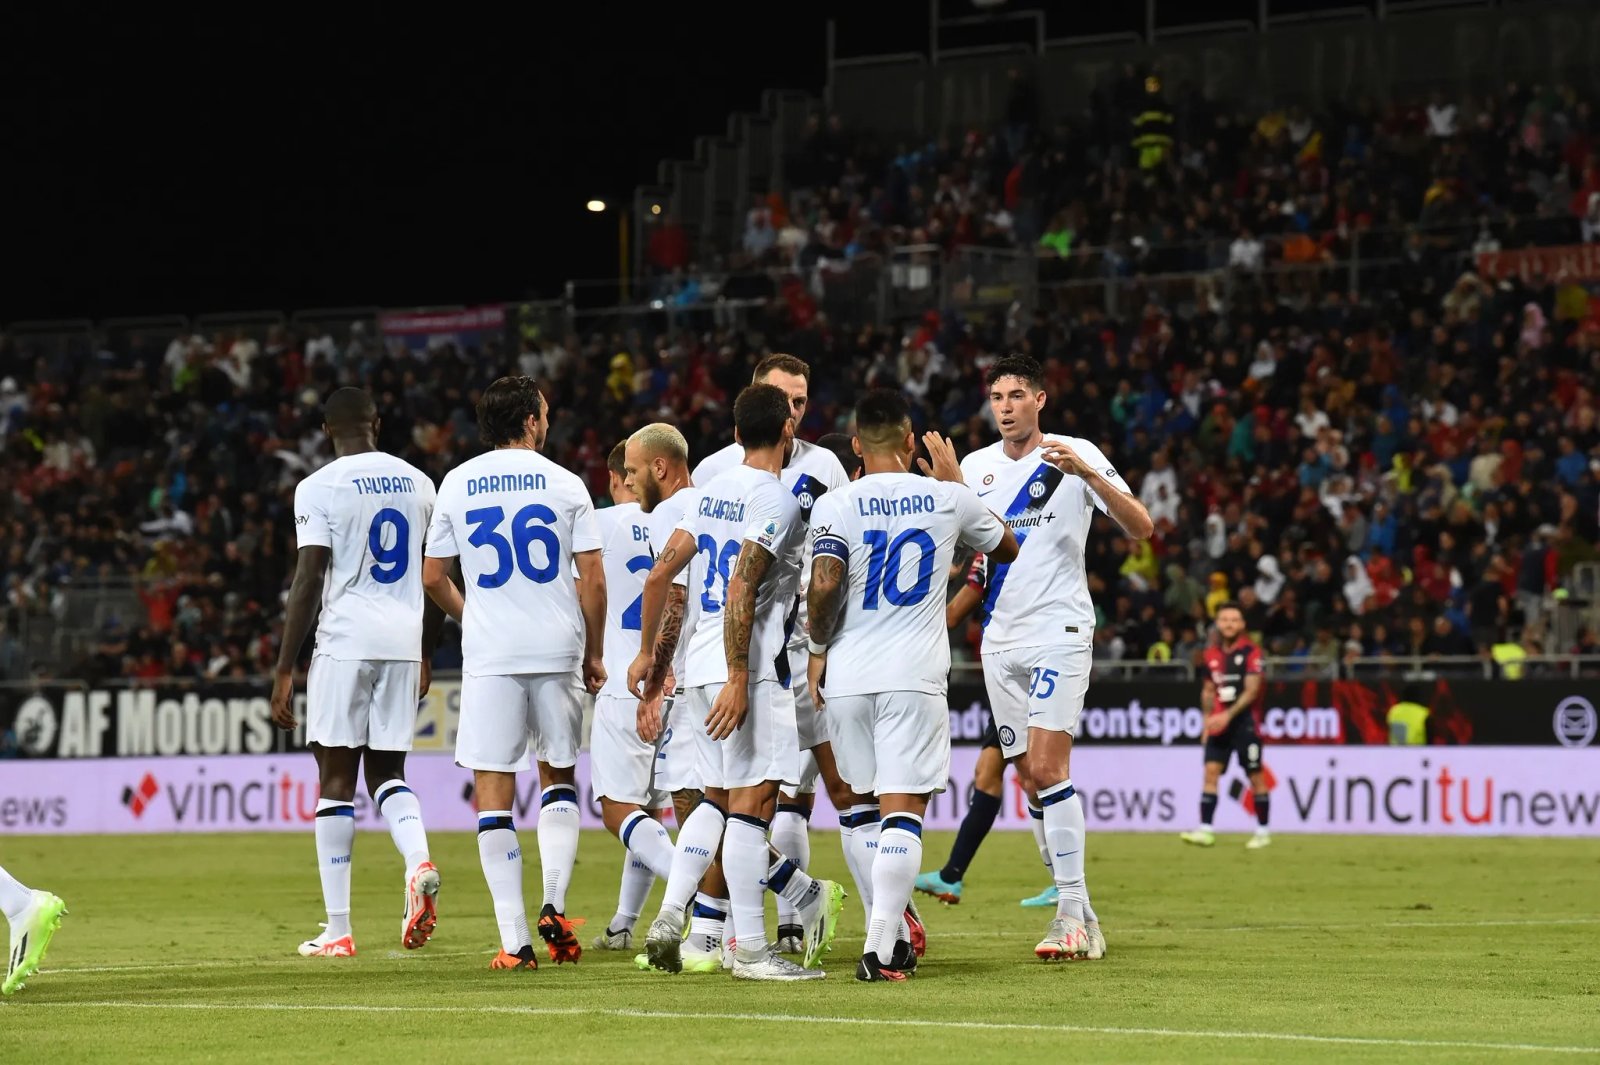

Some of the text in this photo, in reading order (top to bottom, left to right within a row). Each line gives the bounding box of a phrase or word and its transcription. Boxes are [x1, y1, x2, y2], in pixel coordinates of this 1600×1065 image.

[352, 475, 416, 495] THURAM
[467, 473, 546, 496] DARMIAN
[859, 494, 935, 517] LAUTARO
[1004, 512, 1056, 528] mount+
[369, 507, 409, 584] 9
[466, 503, 560, 589] 36
[814, 543, 838, 552] EACE
[862, 527, 936, 611] 10
[621, 555, 655, 630] 2
[58, 690, 111, 756] AF
[117, 689, 273, 755] Motors
[684, 846, 709, 857] INTER
[881, 846, 908, 855] INTER
